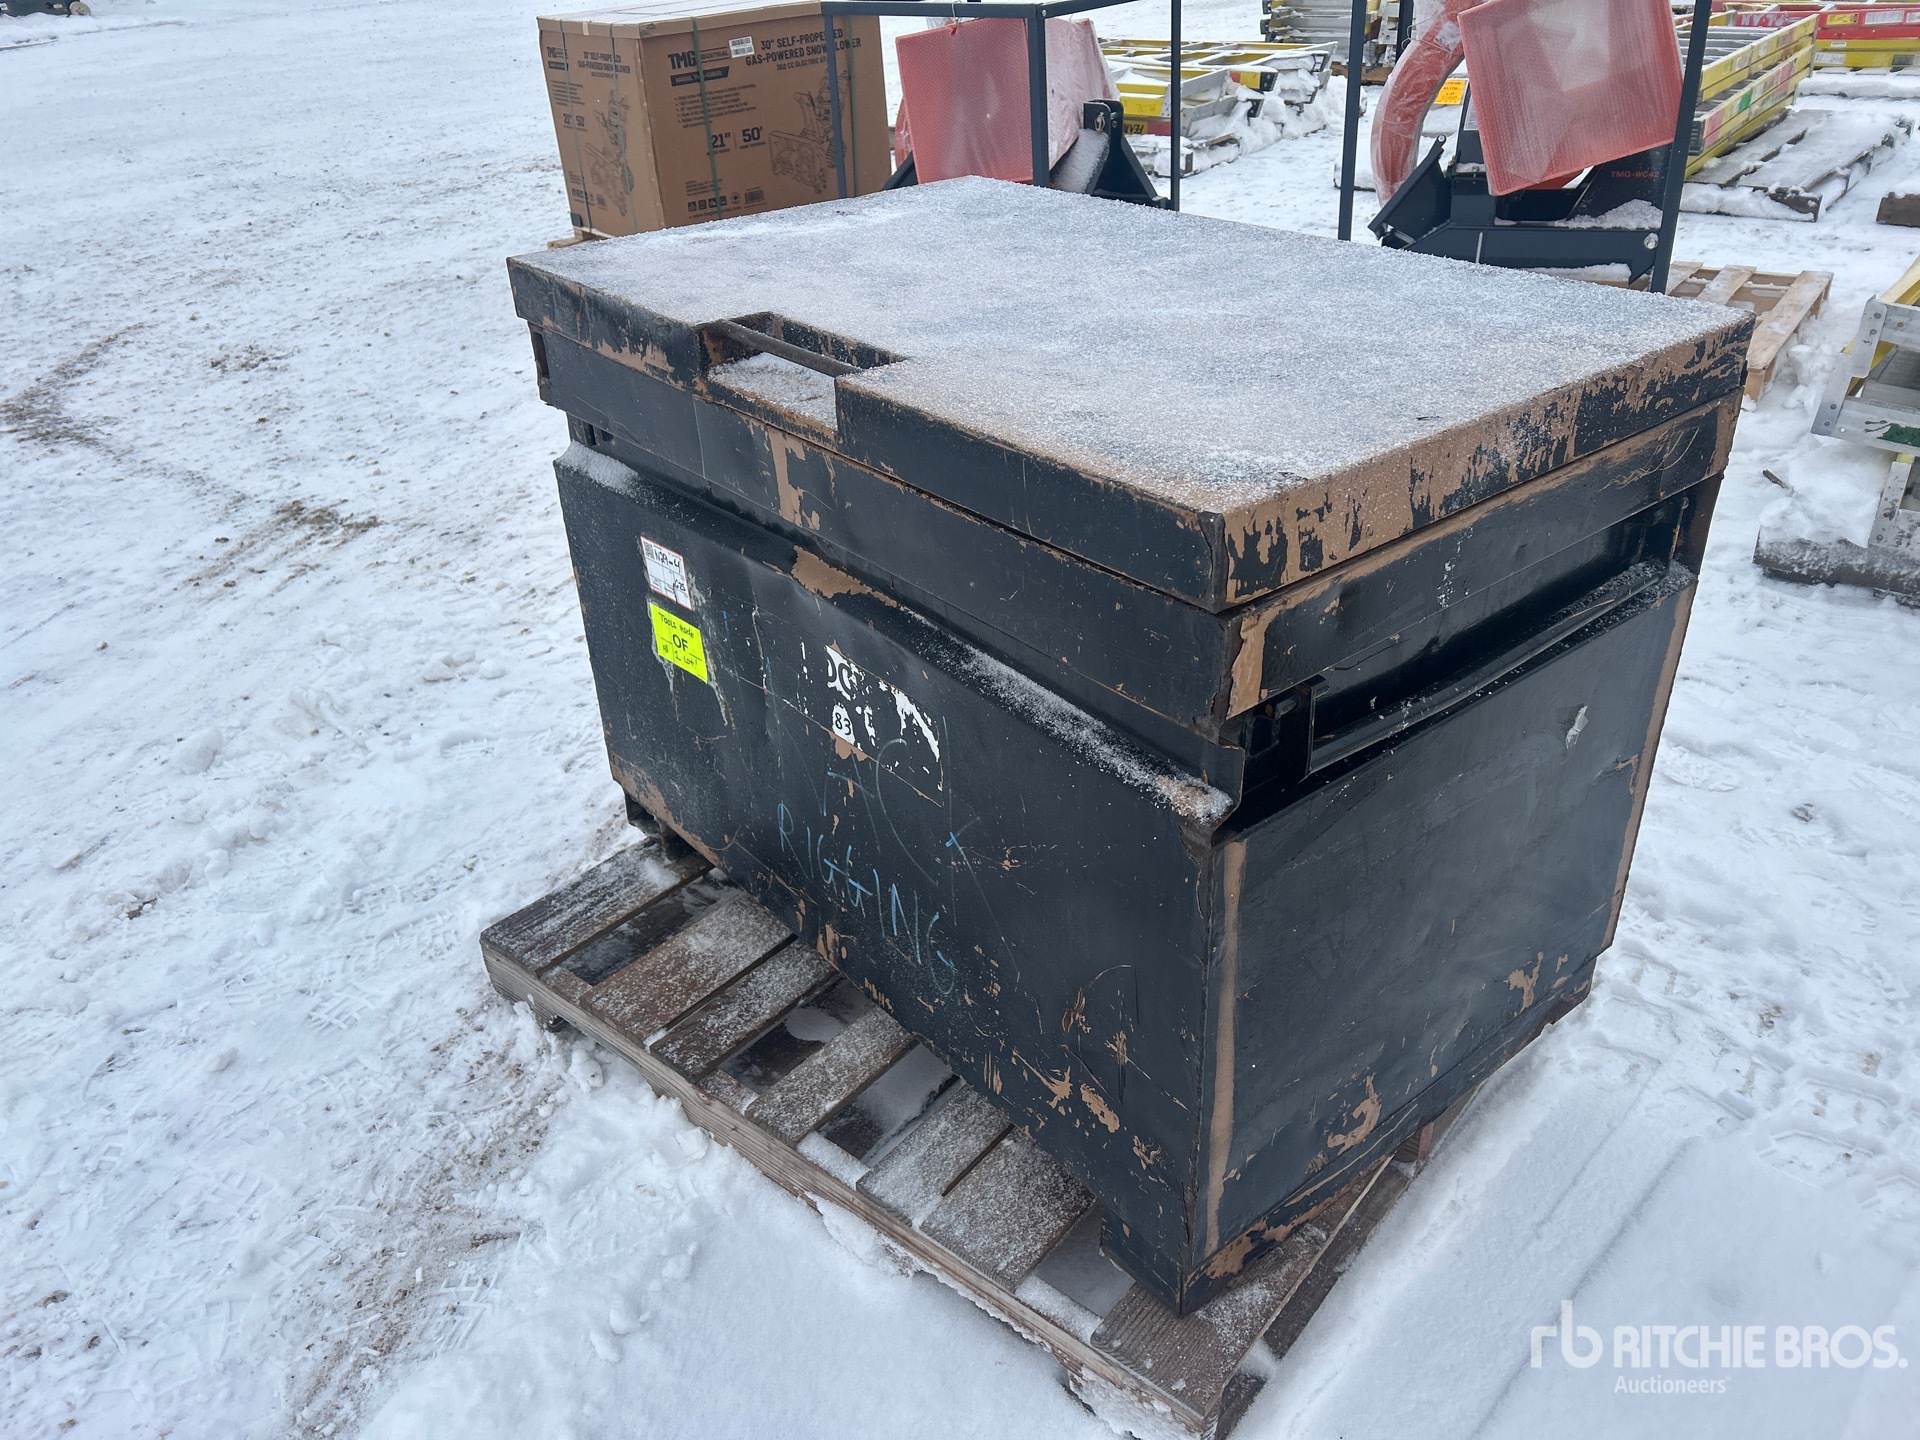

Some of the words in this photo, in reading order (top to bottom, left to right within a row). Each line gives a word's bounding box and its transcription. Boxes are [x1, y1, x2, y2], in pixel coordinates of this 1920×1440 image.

[760, 38, 775, 51] 30"
[777, 28, 843, 49] SELF-PROPEED
[667, 50, 697, 70] TMG
[745, 45, 804, 67] GAS-POWERED
[742, 126, 763, 143] 50'
[1611, 170, 1660, 178] TMG-WC42
[672, 634, 689, 652] OF
[834, 712, 852, 736] 83
[777, 801, 958, 995] RIGGING
